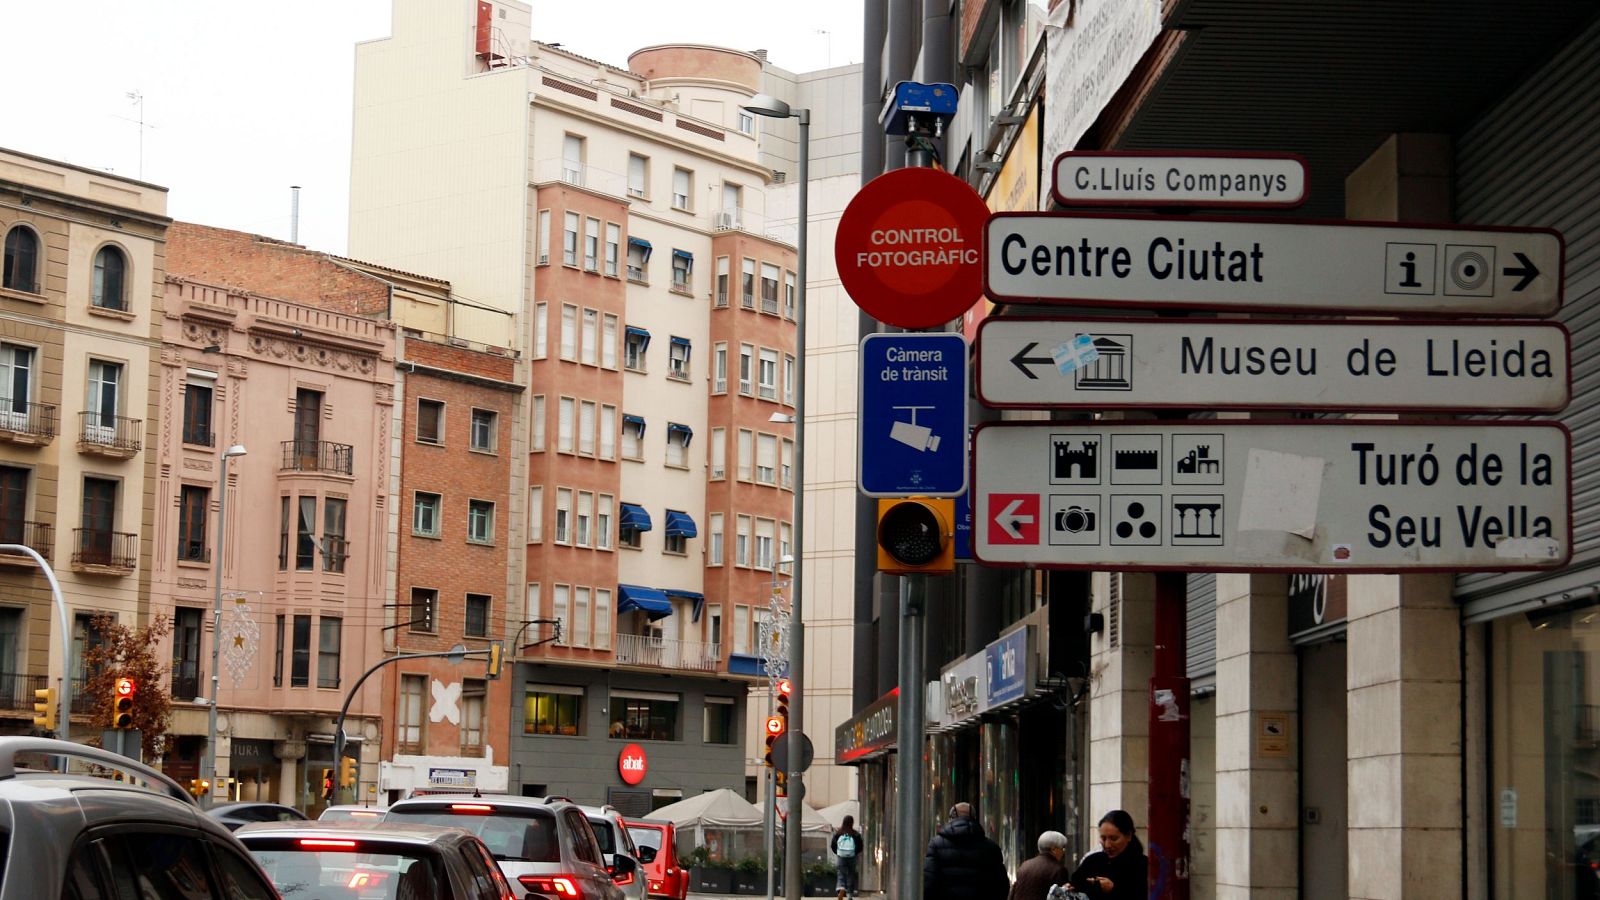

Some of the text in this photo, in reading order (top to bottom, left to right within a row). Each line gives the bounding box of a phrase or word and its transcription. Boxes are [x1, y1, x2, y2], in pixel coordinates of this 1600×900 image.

[1166, 167, 1287, 197] Companys
[871, 228, 964, 245] CONTROL
[856, 246, 979, 268] FOTOGRÀFIC
[1001, 232, 1264, 283] Centre Ciutat
[886, 347, 943, 362] Càmera
[1180, 336, 1553, 379] Museu de Lleida
[880, 366, 948, 381] de trànsit
[1351, 442, 1553, 486] Turó de la
[1367, 503, 1553, 549] Seu Vella
[623, 755, 643, 770] abat
